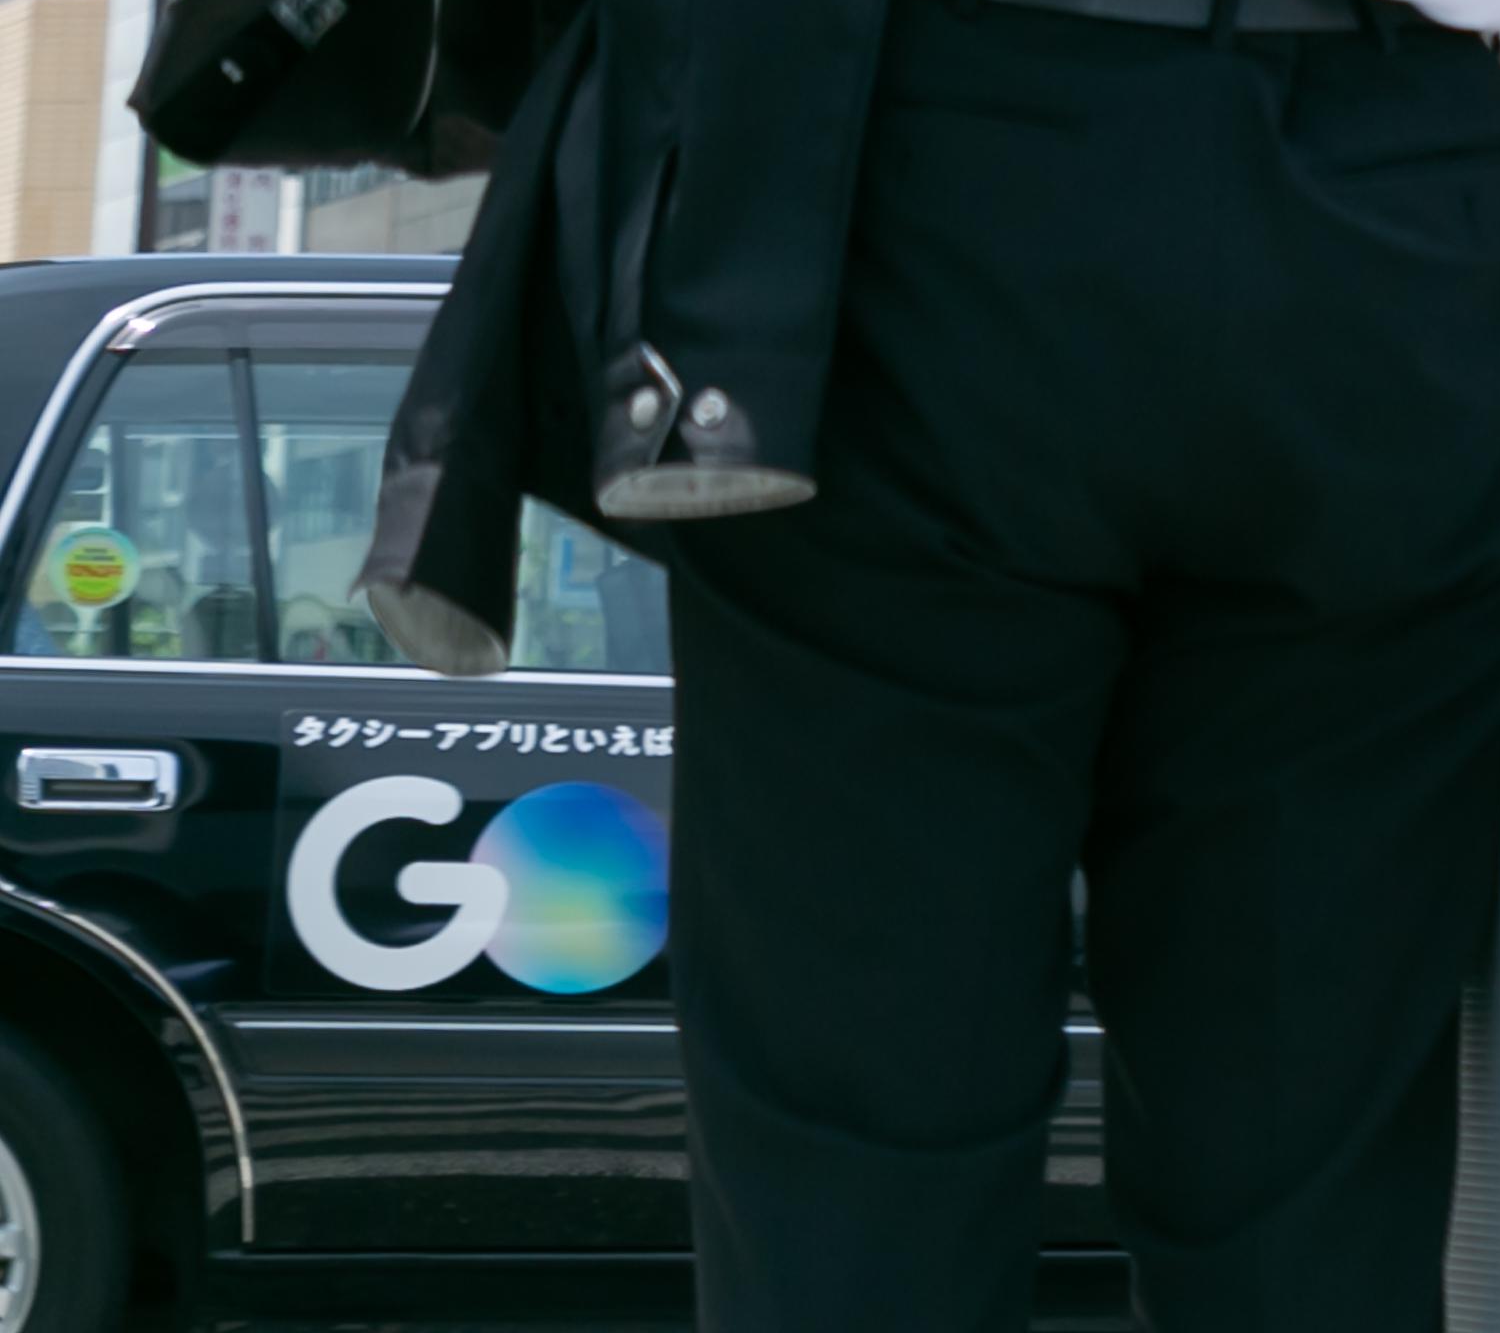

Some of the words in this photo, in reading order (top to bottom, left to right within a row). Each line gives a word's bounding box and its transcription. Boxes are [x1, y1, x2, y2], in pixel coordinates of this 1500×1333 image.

[293, 715, 674, 756] タクシーアプリといえば
[287, 775, 671, 995] GO
